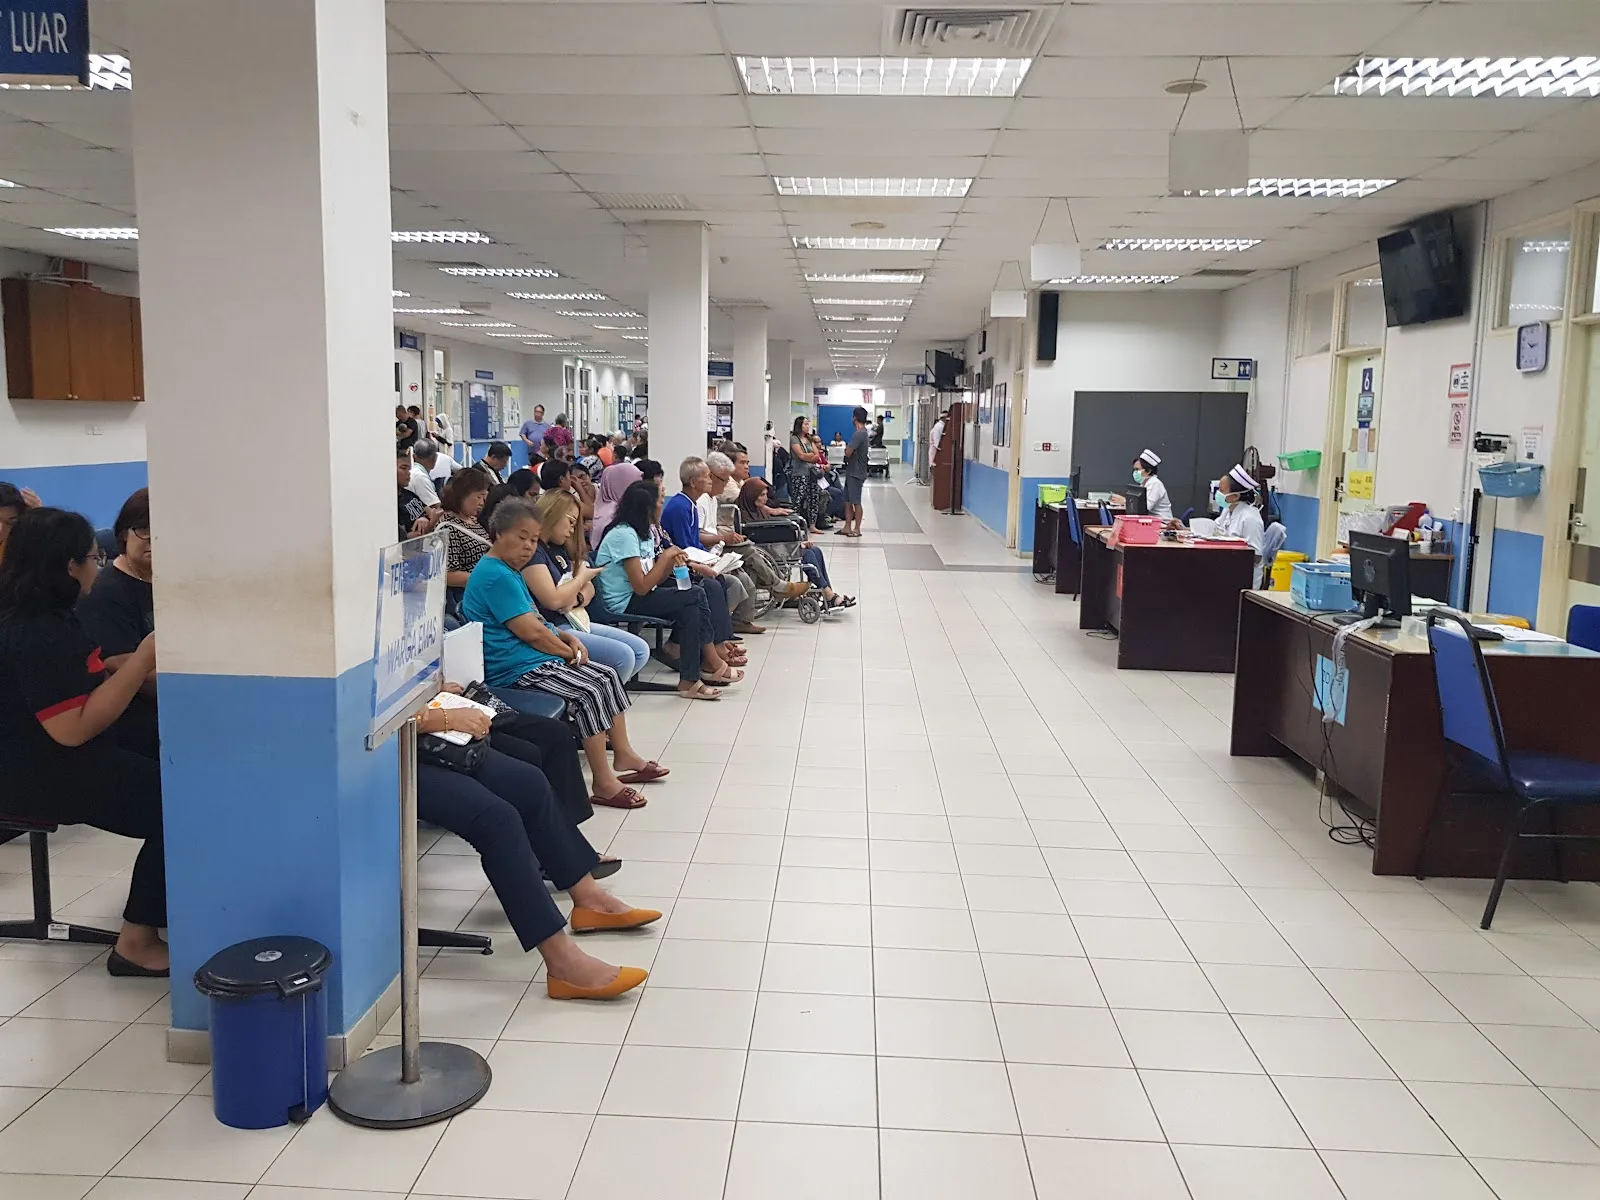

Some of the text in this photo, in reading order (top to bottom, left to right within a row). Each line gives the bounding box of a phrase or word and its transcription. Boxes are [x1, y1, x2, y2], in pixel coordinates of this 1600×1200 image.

[10, 11, 69, 54] LUAR
[1364, 373, 1370, 390] 6
[388, 616, 437, 675] WARGA EMAS
